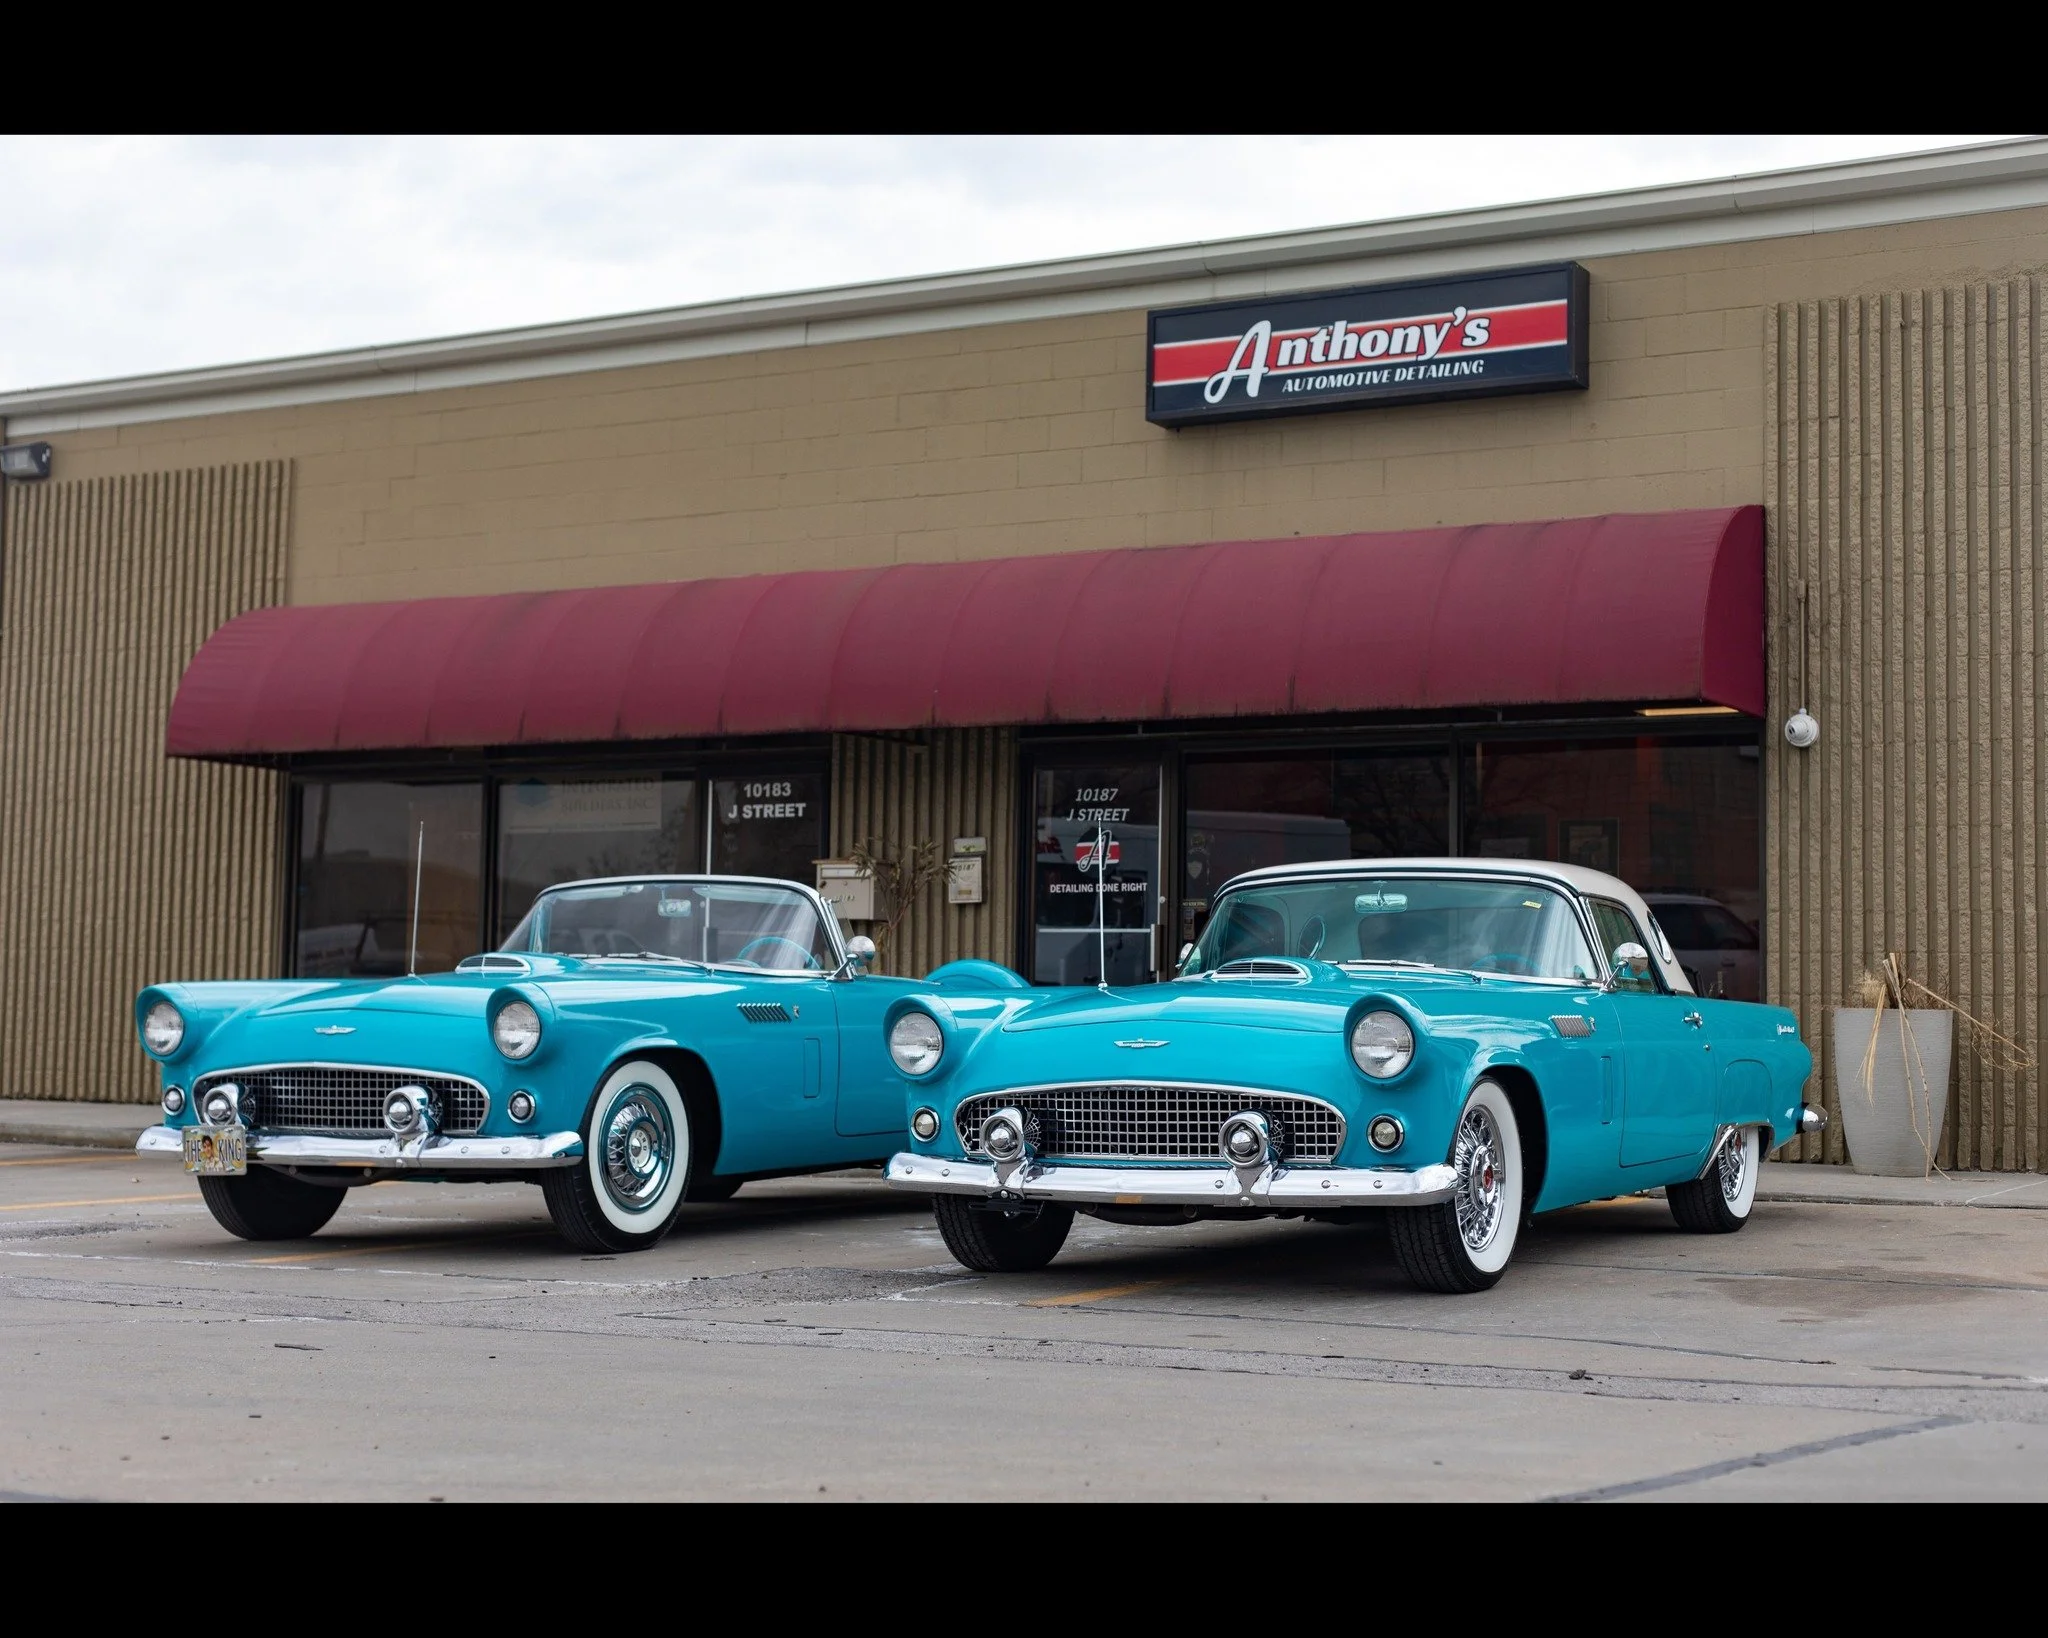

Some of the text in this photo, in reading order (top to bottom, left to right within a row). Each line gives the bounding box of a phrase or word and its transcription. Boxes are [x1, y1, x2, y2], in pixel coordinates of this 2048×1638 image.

[1204, 306, 1490, 404] Anthony's
[1282, 359, 1484, 394] AUTOMOTIVE DETAILING
[744, 782, 792, 798] 10183
[1075, 789, 1119, 801] 10187
[728, 803, 806, 819] J STREET
[1066, 808, 1130, 821] J STREET
[1050, 883, 1147, 893] DETAILING DONE RIGHT
[185, 1138, 242, 1163] THE KING
